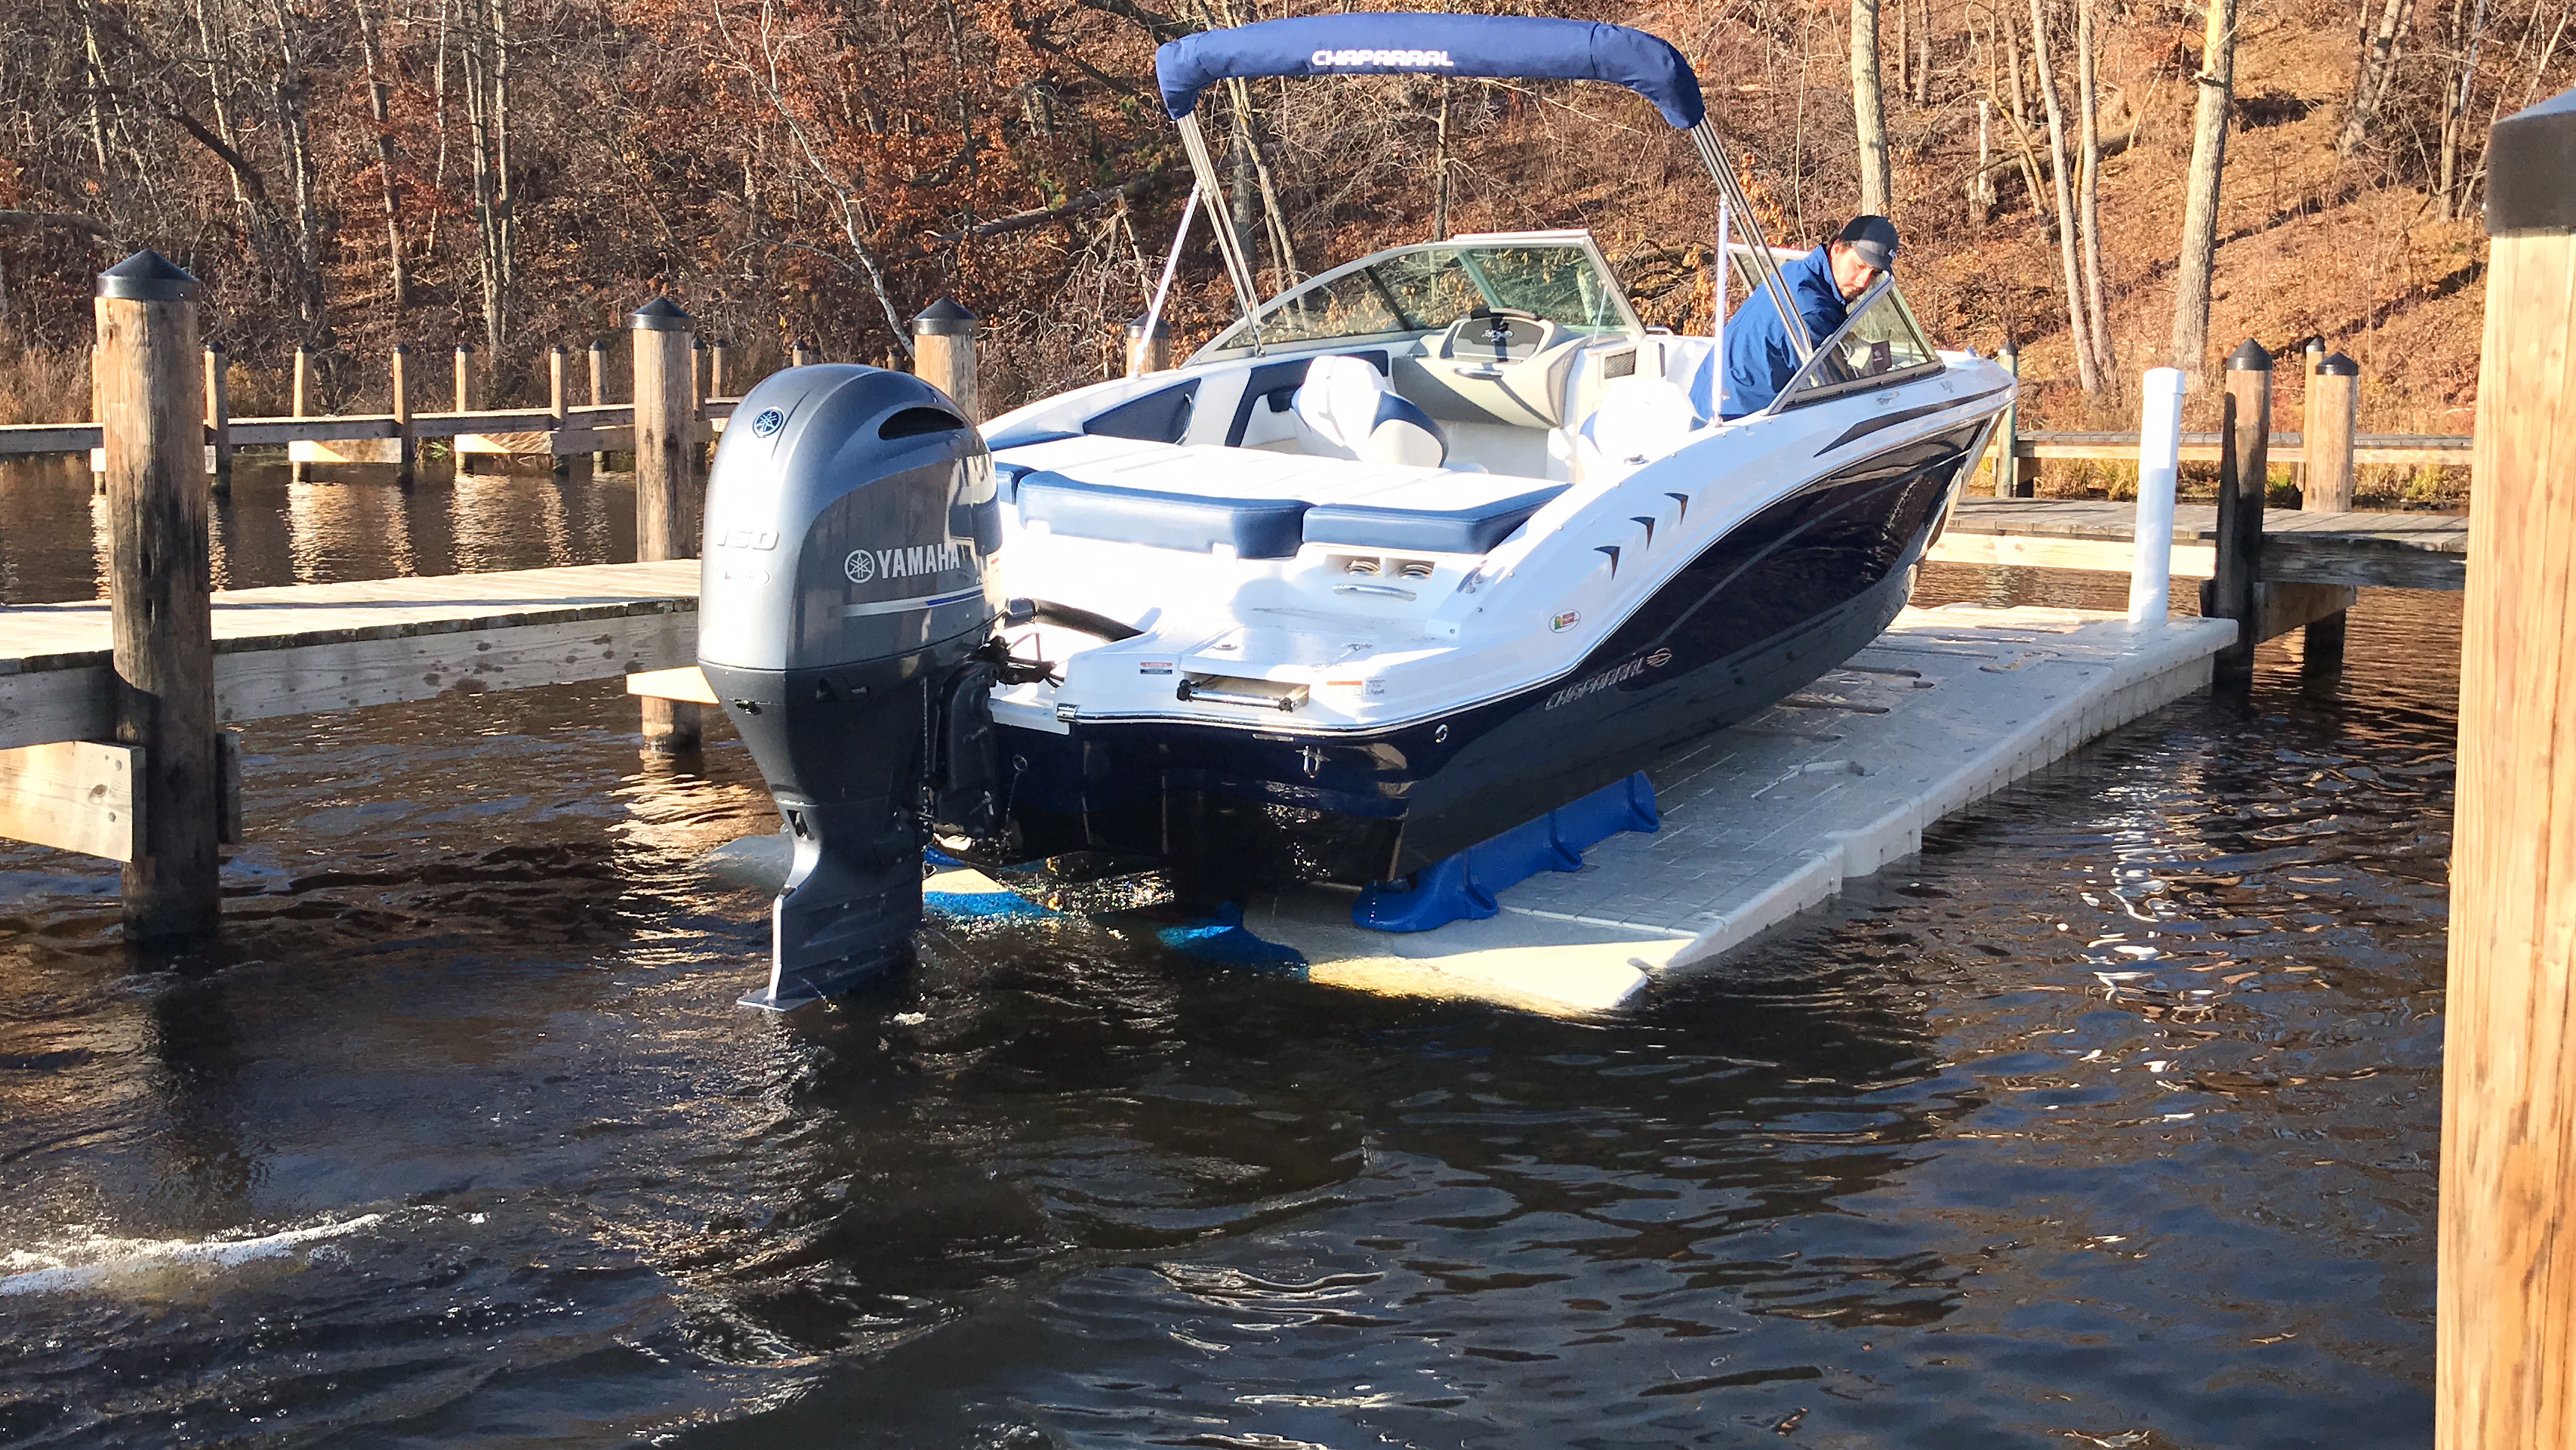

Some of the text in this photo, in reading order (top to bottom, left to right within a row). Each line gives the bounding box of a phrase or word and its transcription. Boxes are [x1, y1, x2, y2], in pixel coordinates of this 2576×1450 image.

[1311, 50, 1454, 66] CHAPARRAL
[716, 527, 779, 551] 150
[877, 542, 960, 579] YAMAHA
[1545, 657, 1644, 711] CHAPARRAL
